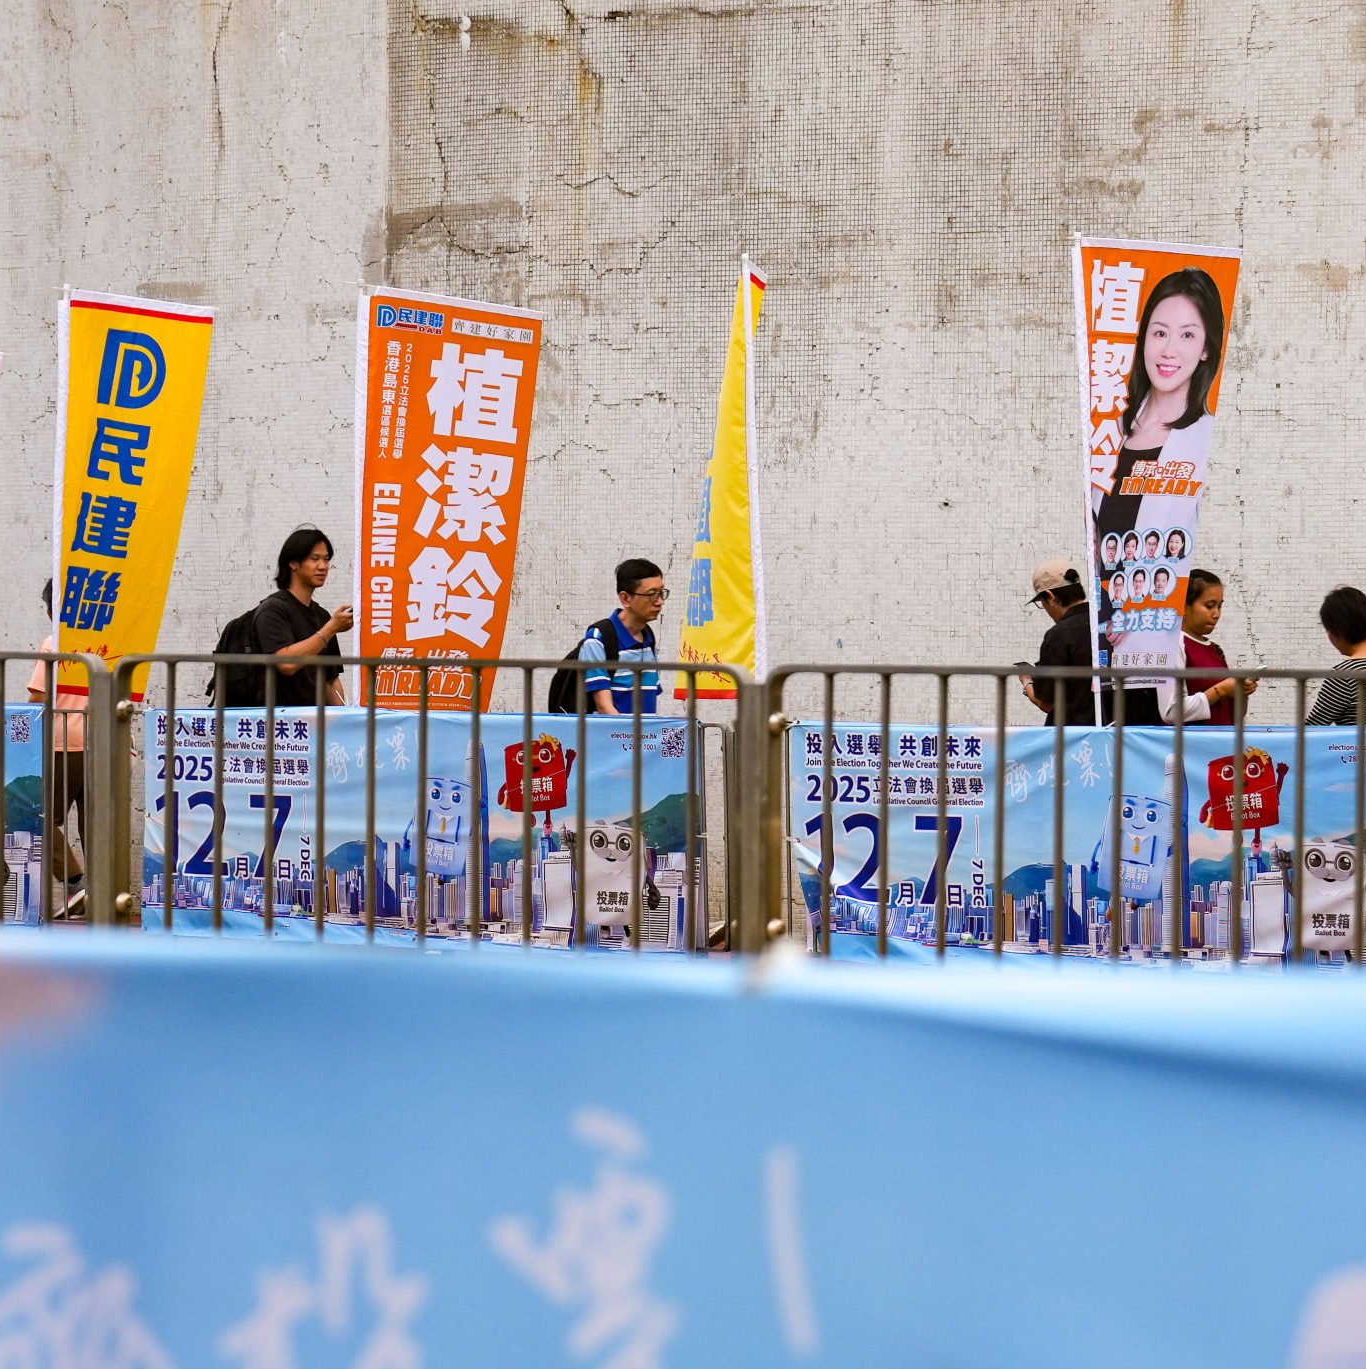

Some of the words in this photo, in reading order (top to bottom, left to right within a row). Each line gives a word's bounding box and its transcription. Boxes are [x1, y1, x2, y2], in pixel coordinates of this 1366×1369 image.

[398, 308, 444, 328] 民建聯
[419, 326, 442, 335] DAB
[405, 342, 524, 649] 植潔鈴
[59, 417, 151, 632] 民建聯
[371, 482, 401, 568] ELAINE
[370, 576, 393, 635] CHIK
[1112, 608, 1175, 632] 全力支持
[184, 739, 211, 748] Election
[806, 758, 822, 767] Join
[837, 758, 866, 767] Election
[903, 760, 914, 768] We
[956, 762, 982, 770] Future
[155, 790, 292, 881] 12月7日
[299, 849, 311, 881] DEC
[596, 890, 629, 907] 投票箱
[971, 873, 985, 908] DEC
[1312, 913, 1350, 930] 投票箱
[1314, 929, 1333, 937] Ballot
